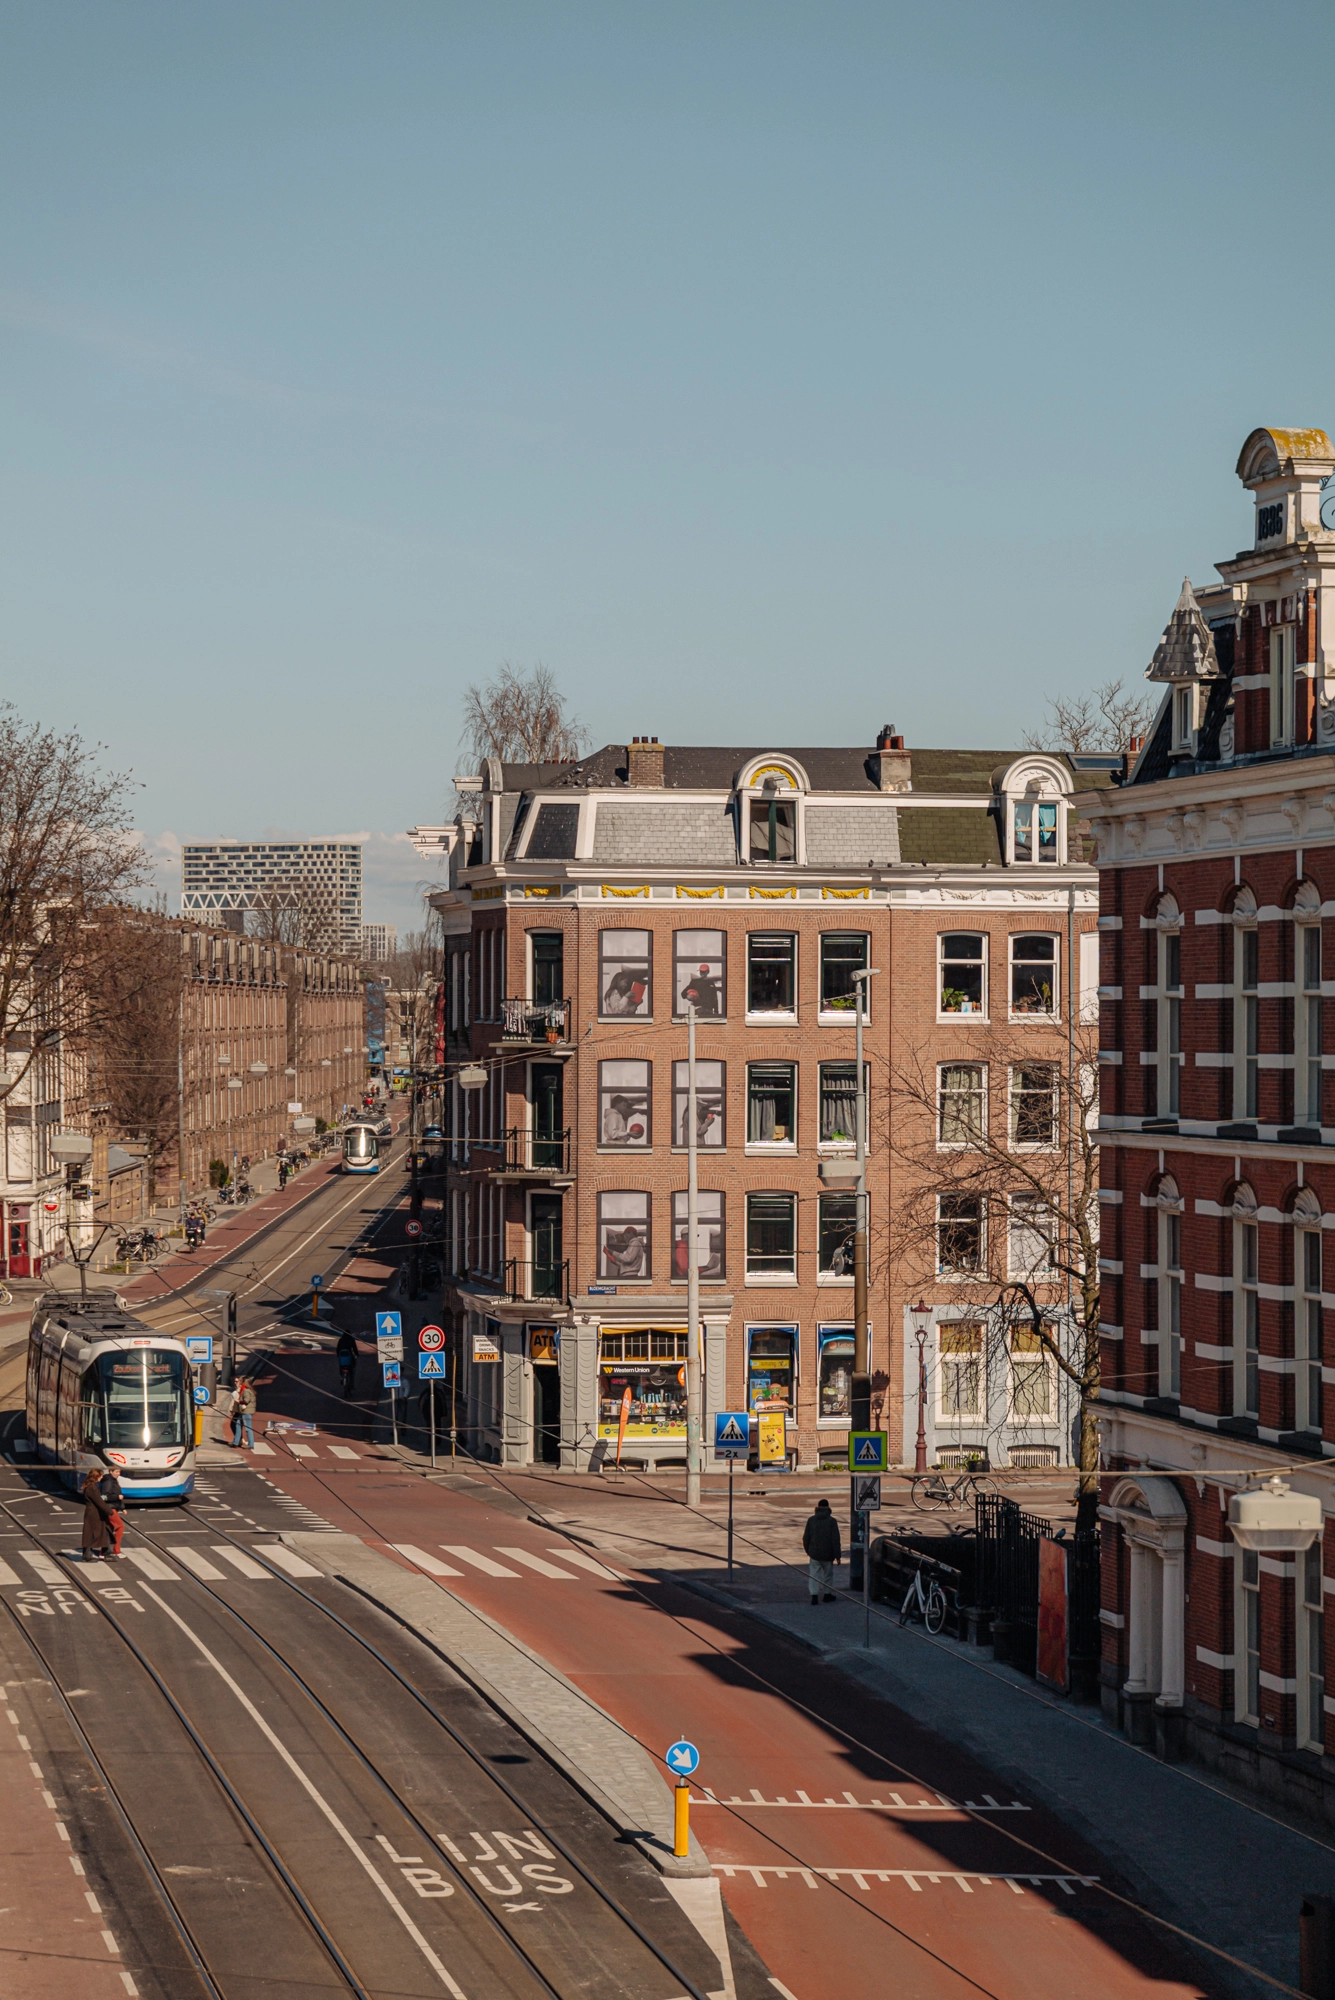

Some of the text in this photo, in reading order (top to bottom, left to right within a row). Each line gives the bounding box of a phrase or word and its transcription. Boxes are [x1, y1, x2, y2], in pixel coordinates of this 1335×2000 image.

[424, 1333, 440, 1344] 30
[113, 1364, 170, 1374] Zoutkeegracht
[375, 1831, 556, 1863] LIJN
[400, 1863, 574, 1898] BUS
